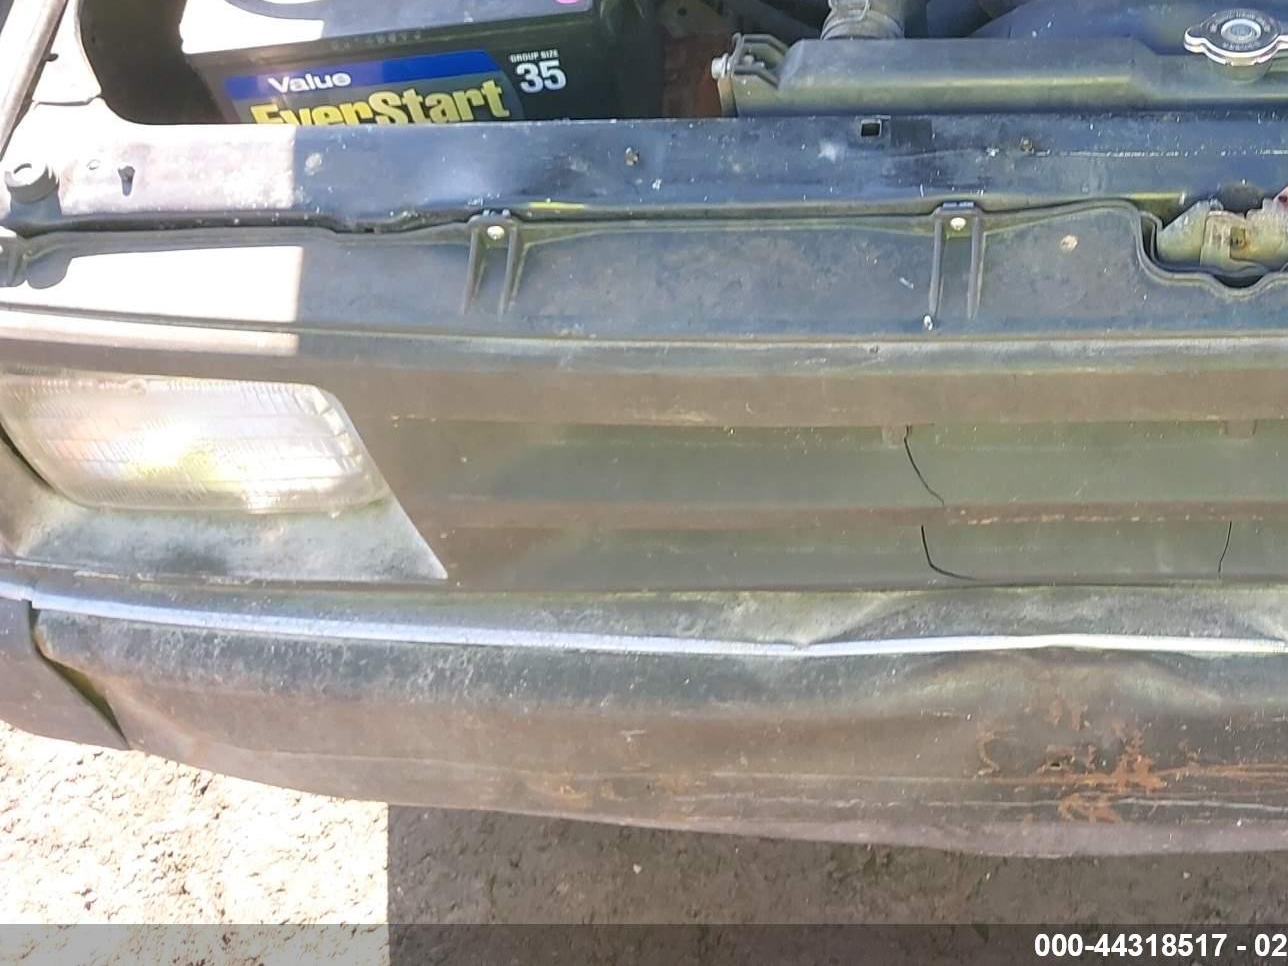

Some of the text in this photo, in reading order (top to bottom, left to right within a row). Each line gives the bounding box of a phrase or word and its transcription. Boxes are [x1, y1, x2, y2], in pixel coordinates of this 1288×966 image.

[509, 48, 559, 63] GROUP SIZE
[267, 72, 352, 94] Value
[516, 59, 567, 94] 35
[250, 79, 511, 126] EverStart
